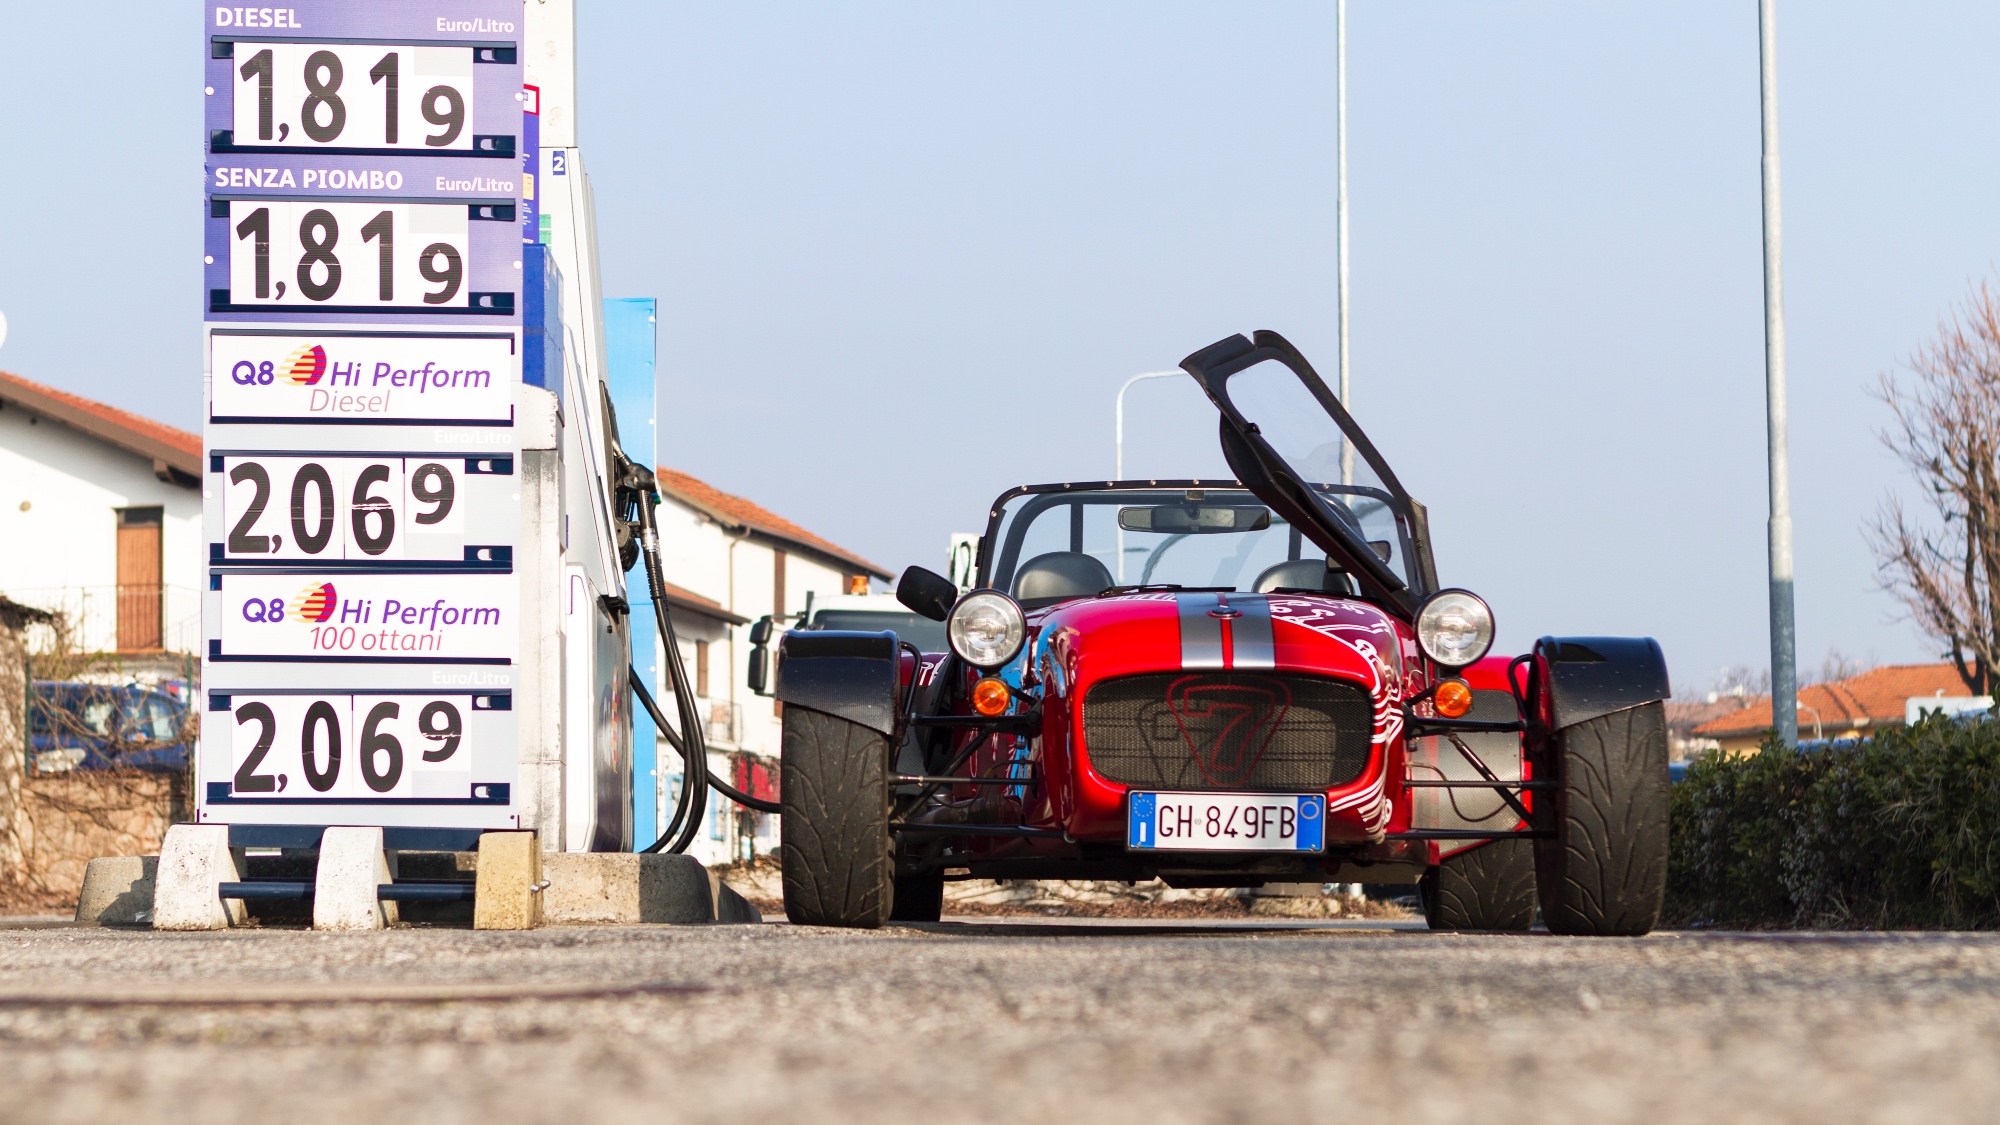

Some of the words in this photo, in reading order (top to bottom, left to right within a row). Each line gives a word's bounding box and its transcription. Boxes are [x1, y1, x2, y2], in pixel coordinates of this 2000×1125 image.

[215, 7, 302, 29] DIESEL
[436, 17, 515, 35] Euro/Litro
[239, 48, 466, 148] 1,819
[553, 156, 565, 172] 2
[215, 168, 297, 190] SENZA
[303, 169, 403, 191] PIOMBO
[435, 176, 514, 193] Euro/Litro
[236, 207, 463, 305] 1,819
[232, 360, 275, 386] Q8
[330, 361, 362, 387] Hi
[372, 361, 491, 394] Perform
[309, 388, 391, 413] Diesel
[433, 429, 512, 445] Euro/Litro
[228, 461, 455, 556] 2,069
[242, 597, 285, 623] Q8
[340, 599, 372, 624] Hi
[382, 599, 501, 632] Perform
[309, 626, 356, 651] 100
[361, 629, 443, 651] ottani
[431, 670, 511, 686] Euro/Litro
[1183, 685, 1276, 771] 7
[234, 700, 463, 793] 2,069
[1158, 804, 1194, 838] GH
[1205, 804, 1297, 839] 849FB
